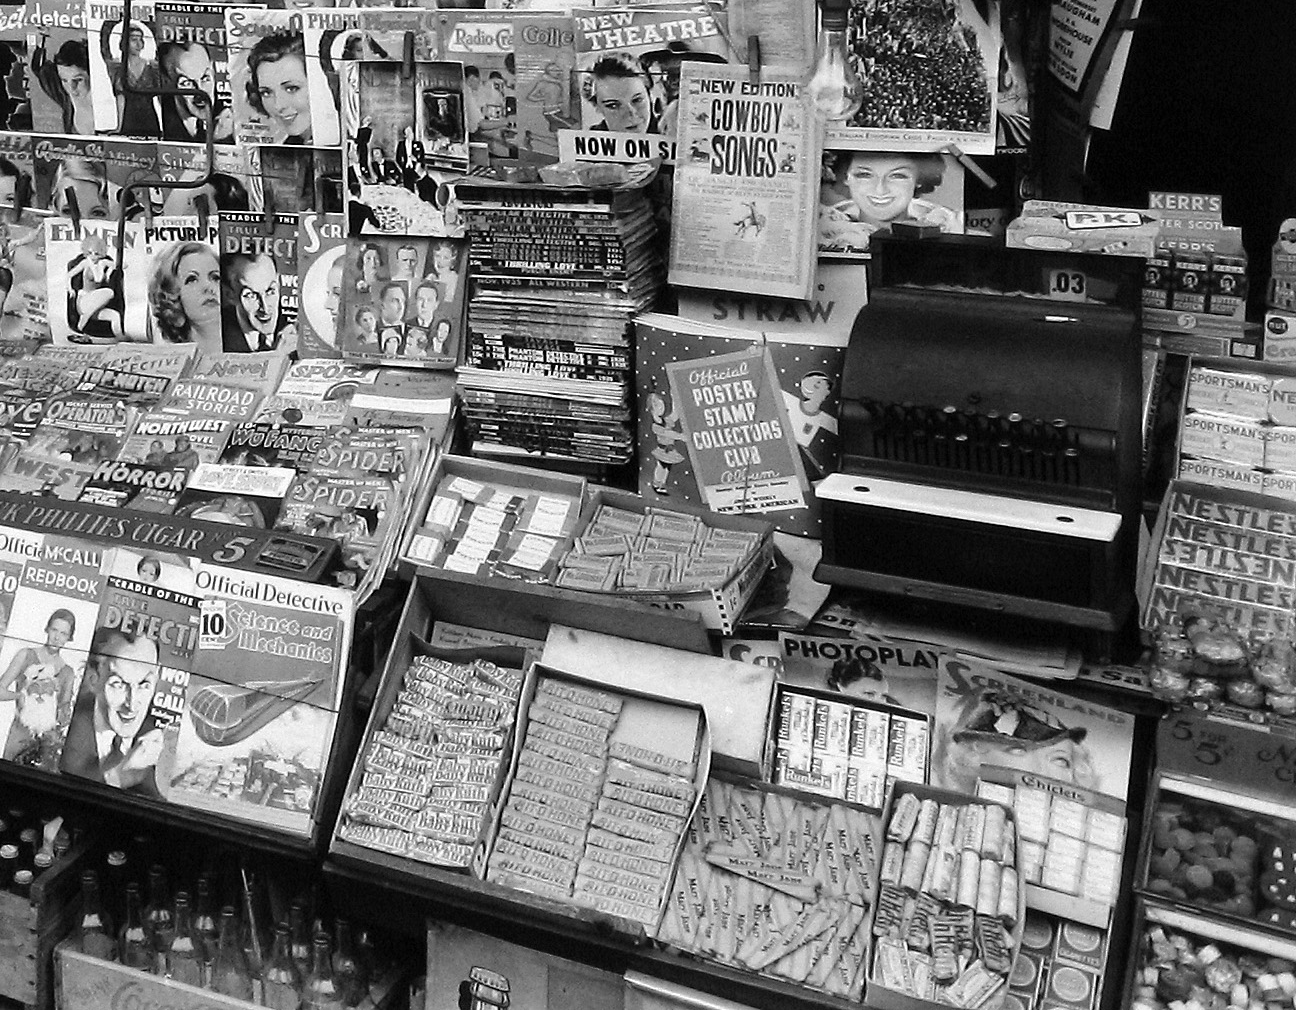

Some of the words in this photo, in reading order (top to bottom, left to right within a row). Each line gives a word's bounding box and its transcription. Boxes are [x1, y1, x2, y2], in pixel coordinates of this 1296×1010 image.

[581, 12, 635, 31] NEW
[584, 17, 718, 50] THEATRE
[700, 78, 736, 95] NEW
[710, 98, 783, 135] COWBOY
[574, 135, 615, 157] NOW
[625, 138, 651, 160] ON
[710, 135, 778, 178] SONGS
[1150, 193, 1221, 213] KERR'S
[712, 299, 835, 326] STRAW
[171, 382, 254, 407] RAILROAD
[691, 379, 758, 407] POSTER
[1189, 370, 1269, 395] SPORTSMAN'S
[186, 398, 249, 417] STORIES
[703, 403, 757, 427] STAMP
[692, 418, 782, 452] COLLECTORS
[1184, 416, 1266, 442] SPORTSMAN'S
[318, 440, 404, 472] SPIDER
[723, 444, 762, 468] CLUB
[294, 474, 387, 510] SPIDER
[130, 520, 205, 552] CIGAR
[24, 565, 99, 596] REDBOOK
[195, 570, 260, 600] Official
[263, 580, 344, 616] Detective
[155, 589, 171, 601] OF
[174, 592, 195, 607] THE
[201, 612, 224, 637] 10
[299, 622, 333, 643] and
[237, 632, 333, 665] Mechanics
[784, 636, 944, 672] PHOTOPLAY
